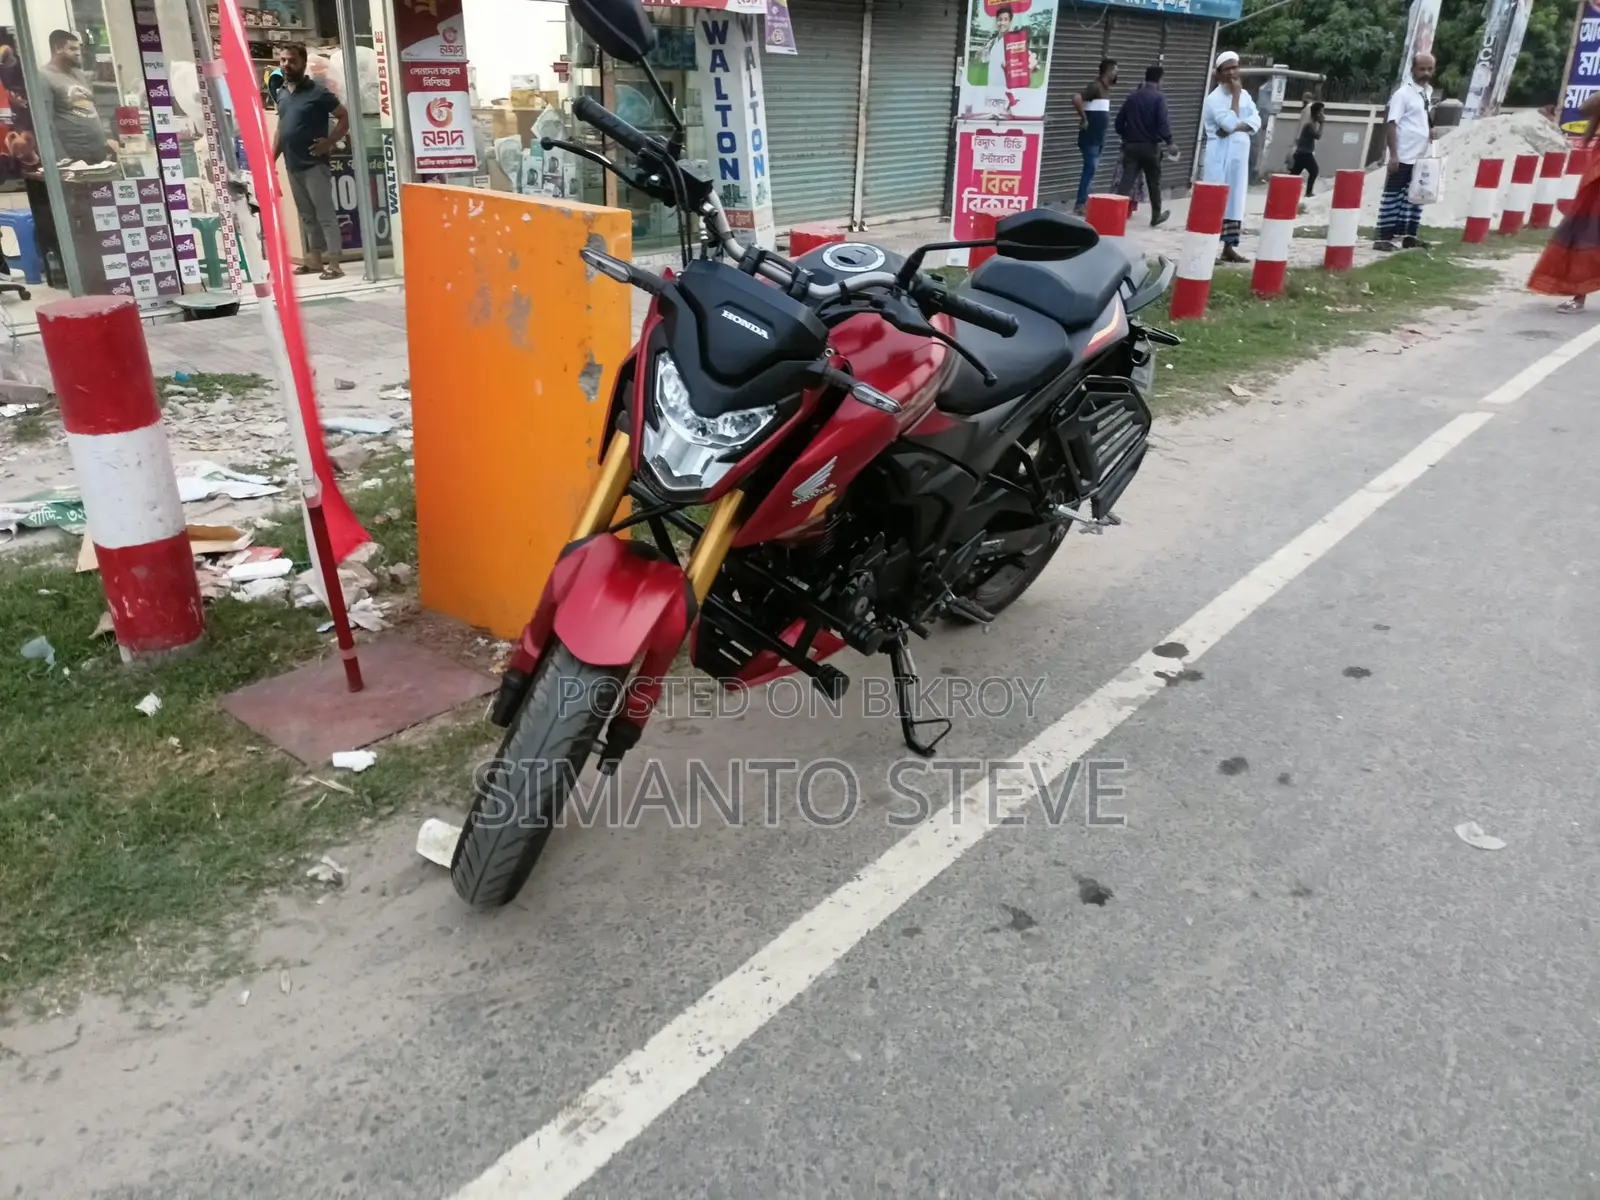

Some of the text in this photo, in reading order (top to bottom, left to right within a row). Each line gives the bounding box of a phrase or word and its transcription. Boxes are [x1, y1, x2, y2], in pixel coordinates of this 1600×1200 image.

[702, 20, 740, 180] WALTON
[740, 15, 765, 179] WALTON
[374, 31, 399, 215] WALTON MOBILE
[421, 130, 465, 147] নগদ
[1003, 137, 1022, 149] টিভি
[980, 169, 1021, 195] বিল
[961, 187, 1028, 213] বিকাশ
[721, 309, 769, 340] HONDA
